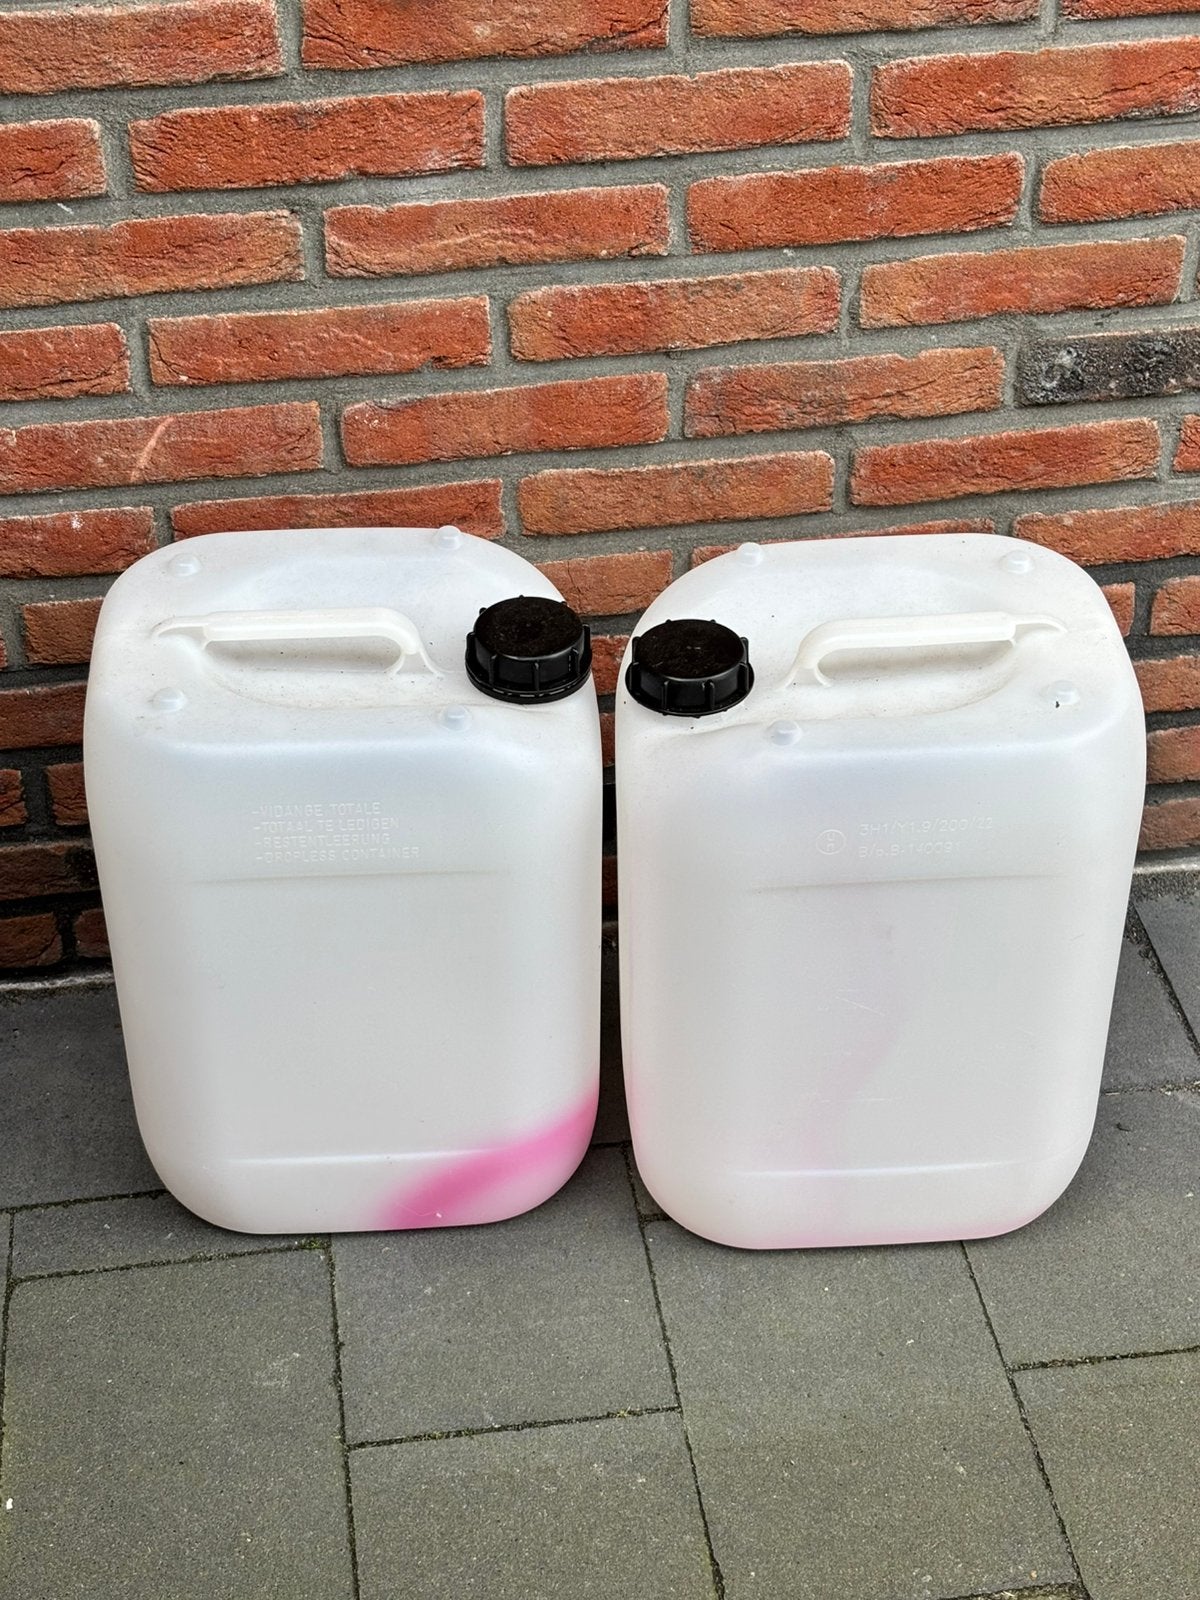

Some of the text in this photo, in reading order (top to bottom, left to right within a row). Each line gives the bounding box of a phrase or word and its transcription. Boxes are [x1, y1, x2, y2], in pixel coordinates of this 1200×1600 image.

[329, 801, 381, 816] TOTALE
[316, 819, 334, 832] TE
[339, 817, 400, 832] LEDIGEN
[341, 846, 421, 861] CONTAINER
